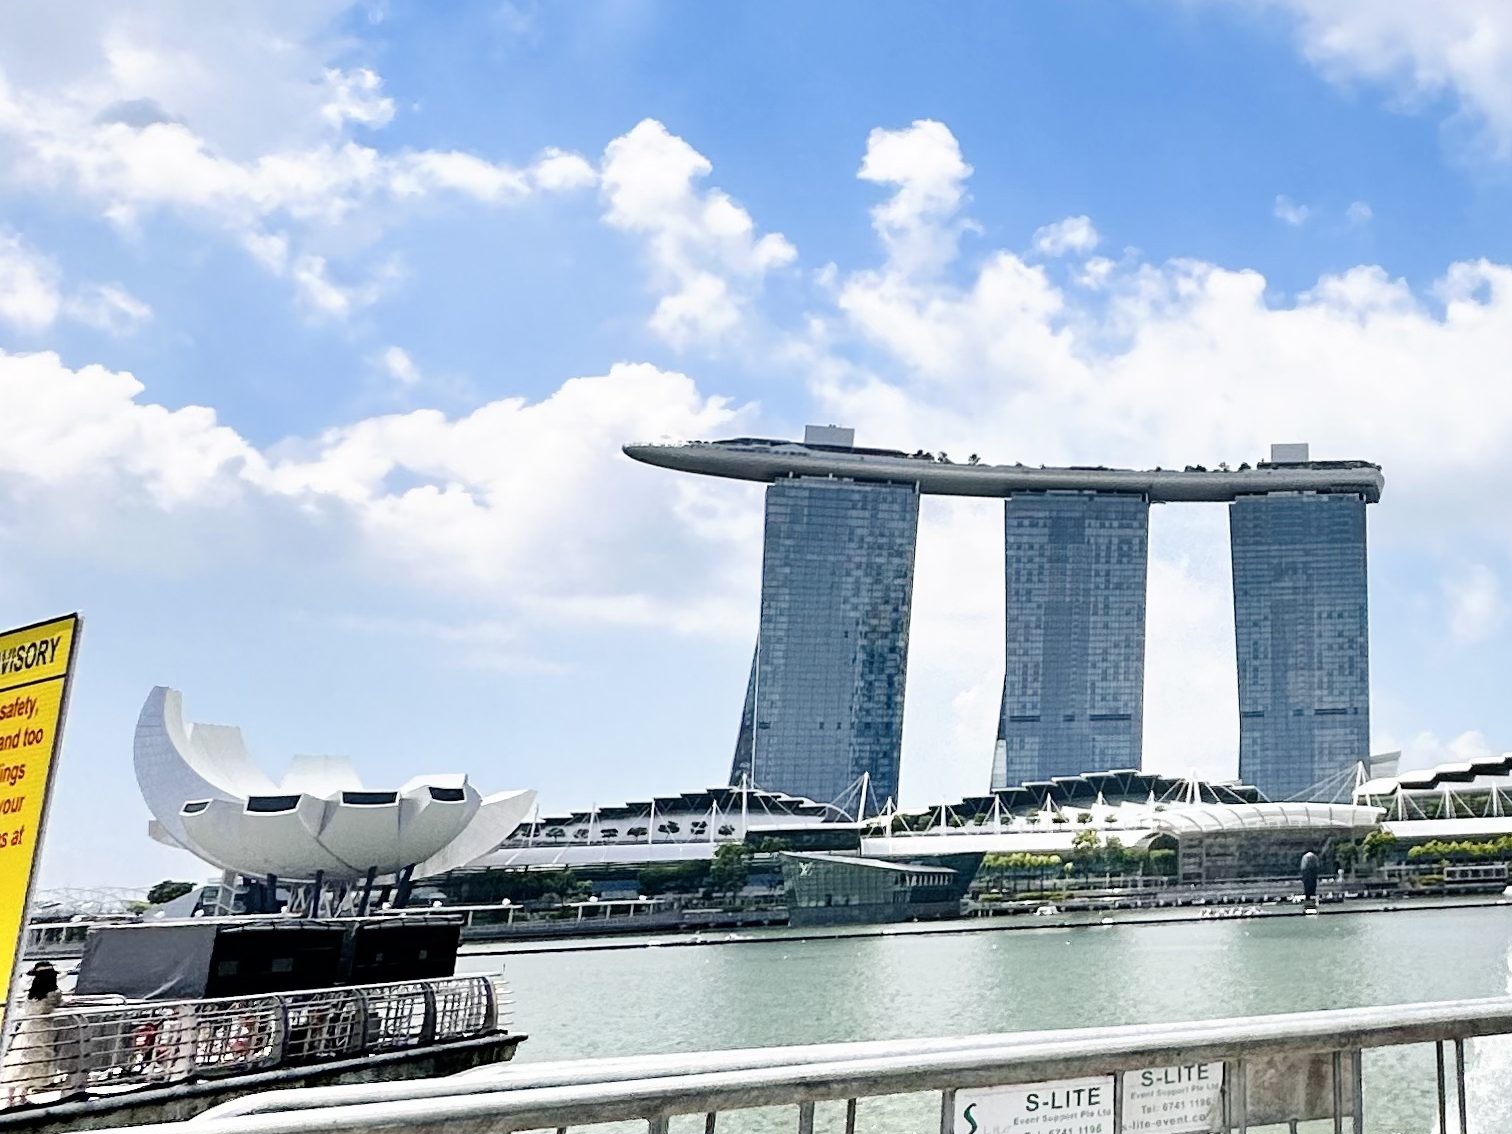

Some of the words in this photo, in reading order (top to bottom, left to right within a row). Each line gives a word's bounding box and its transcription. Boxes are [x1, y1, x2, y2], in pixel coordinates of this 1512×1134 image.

[23, 727, 44, 748] too
[1141, 1063, 1209, 1087] S-LITE
[1026, 1086, 1101, 1112] S-LITE
